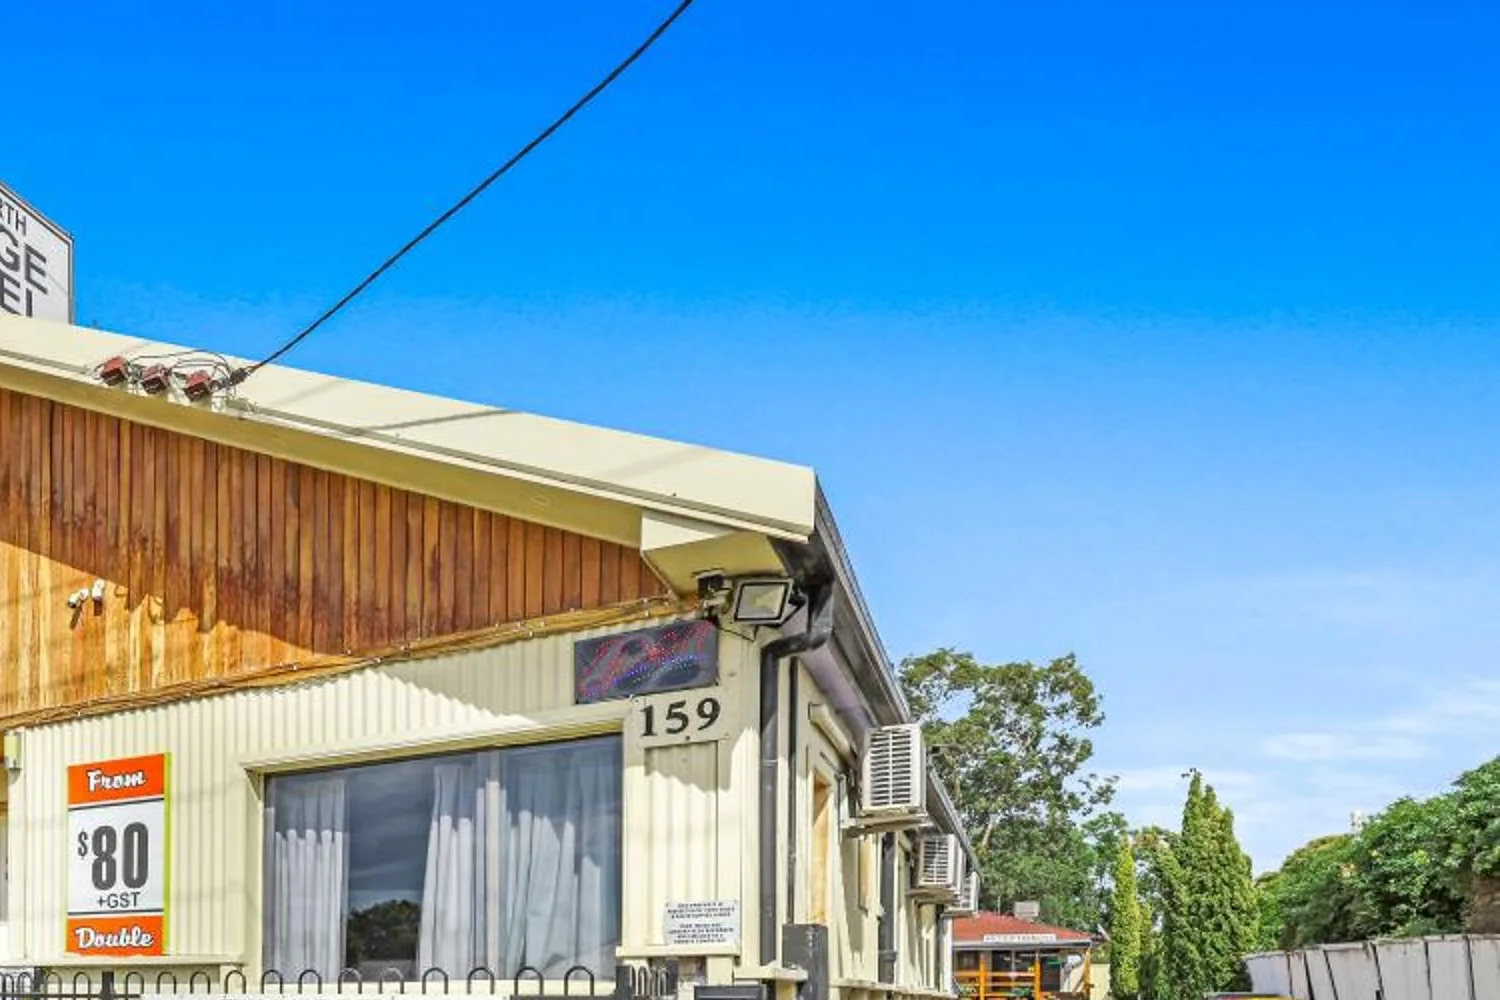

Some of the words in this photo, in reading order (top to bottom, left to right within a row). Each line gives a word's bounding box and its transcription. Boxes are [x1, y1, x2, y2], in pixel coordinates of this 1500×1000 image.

[639, 697, 721, 737] 159
[86, 768, 147, 792] From
[77, 821, 149, 891] $80
[96, 892, 141, 909] +GST
[75, 926, 154, 948] Double
